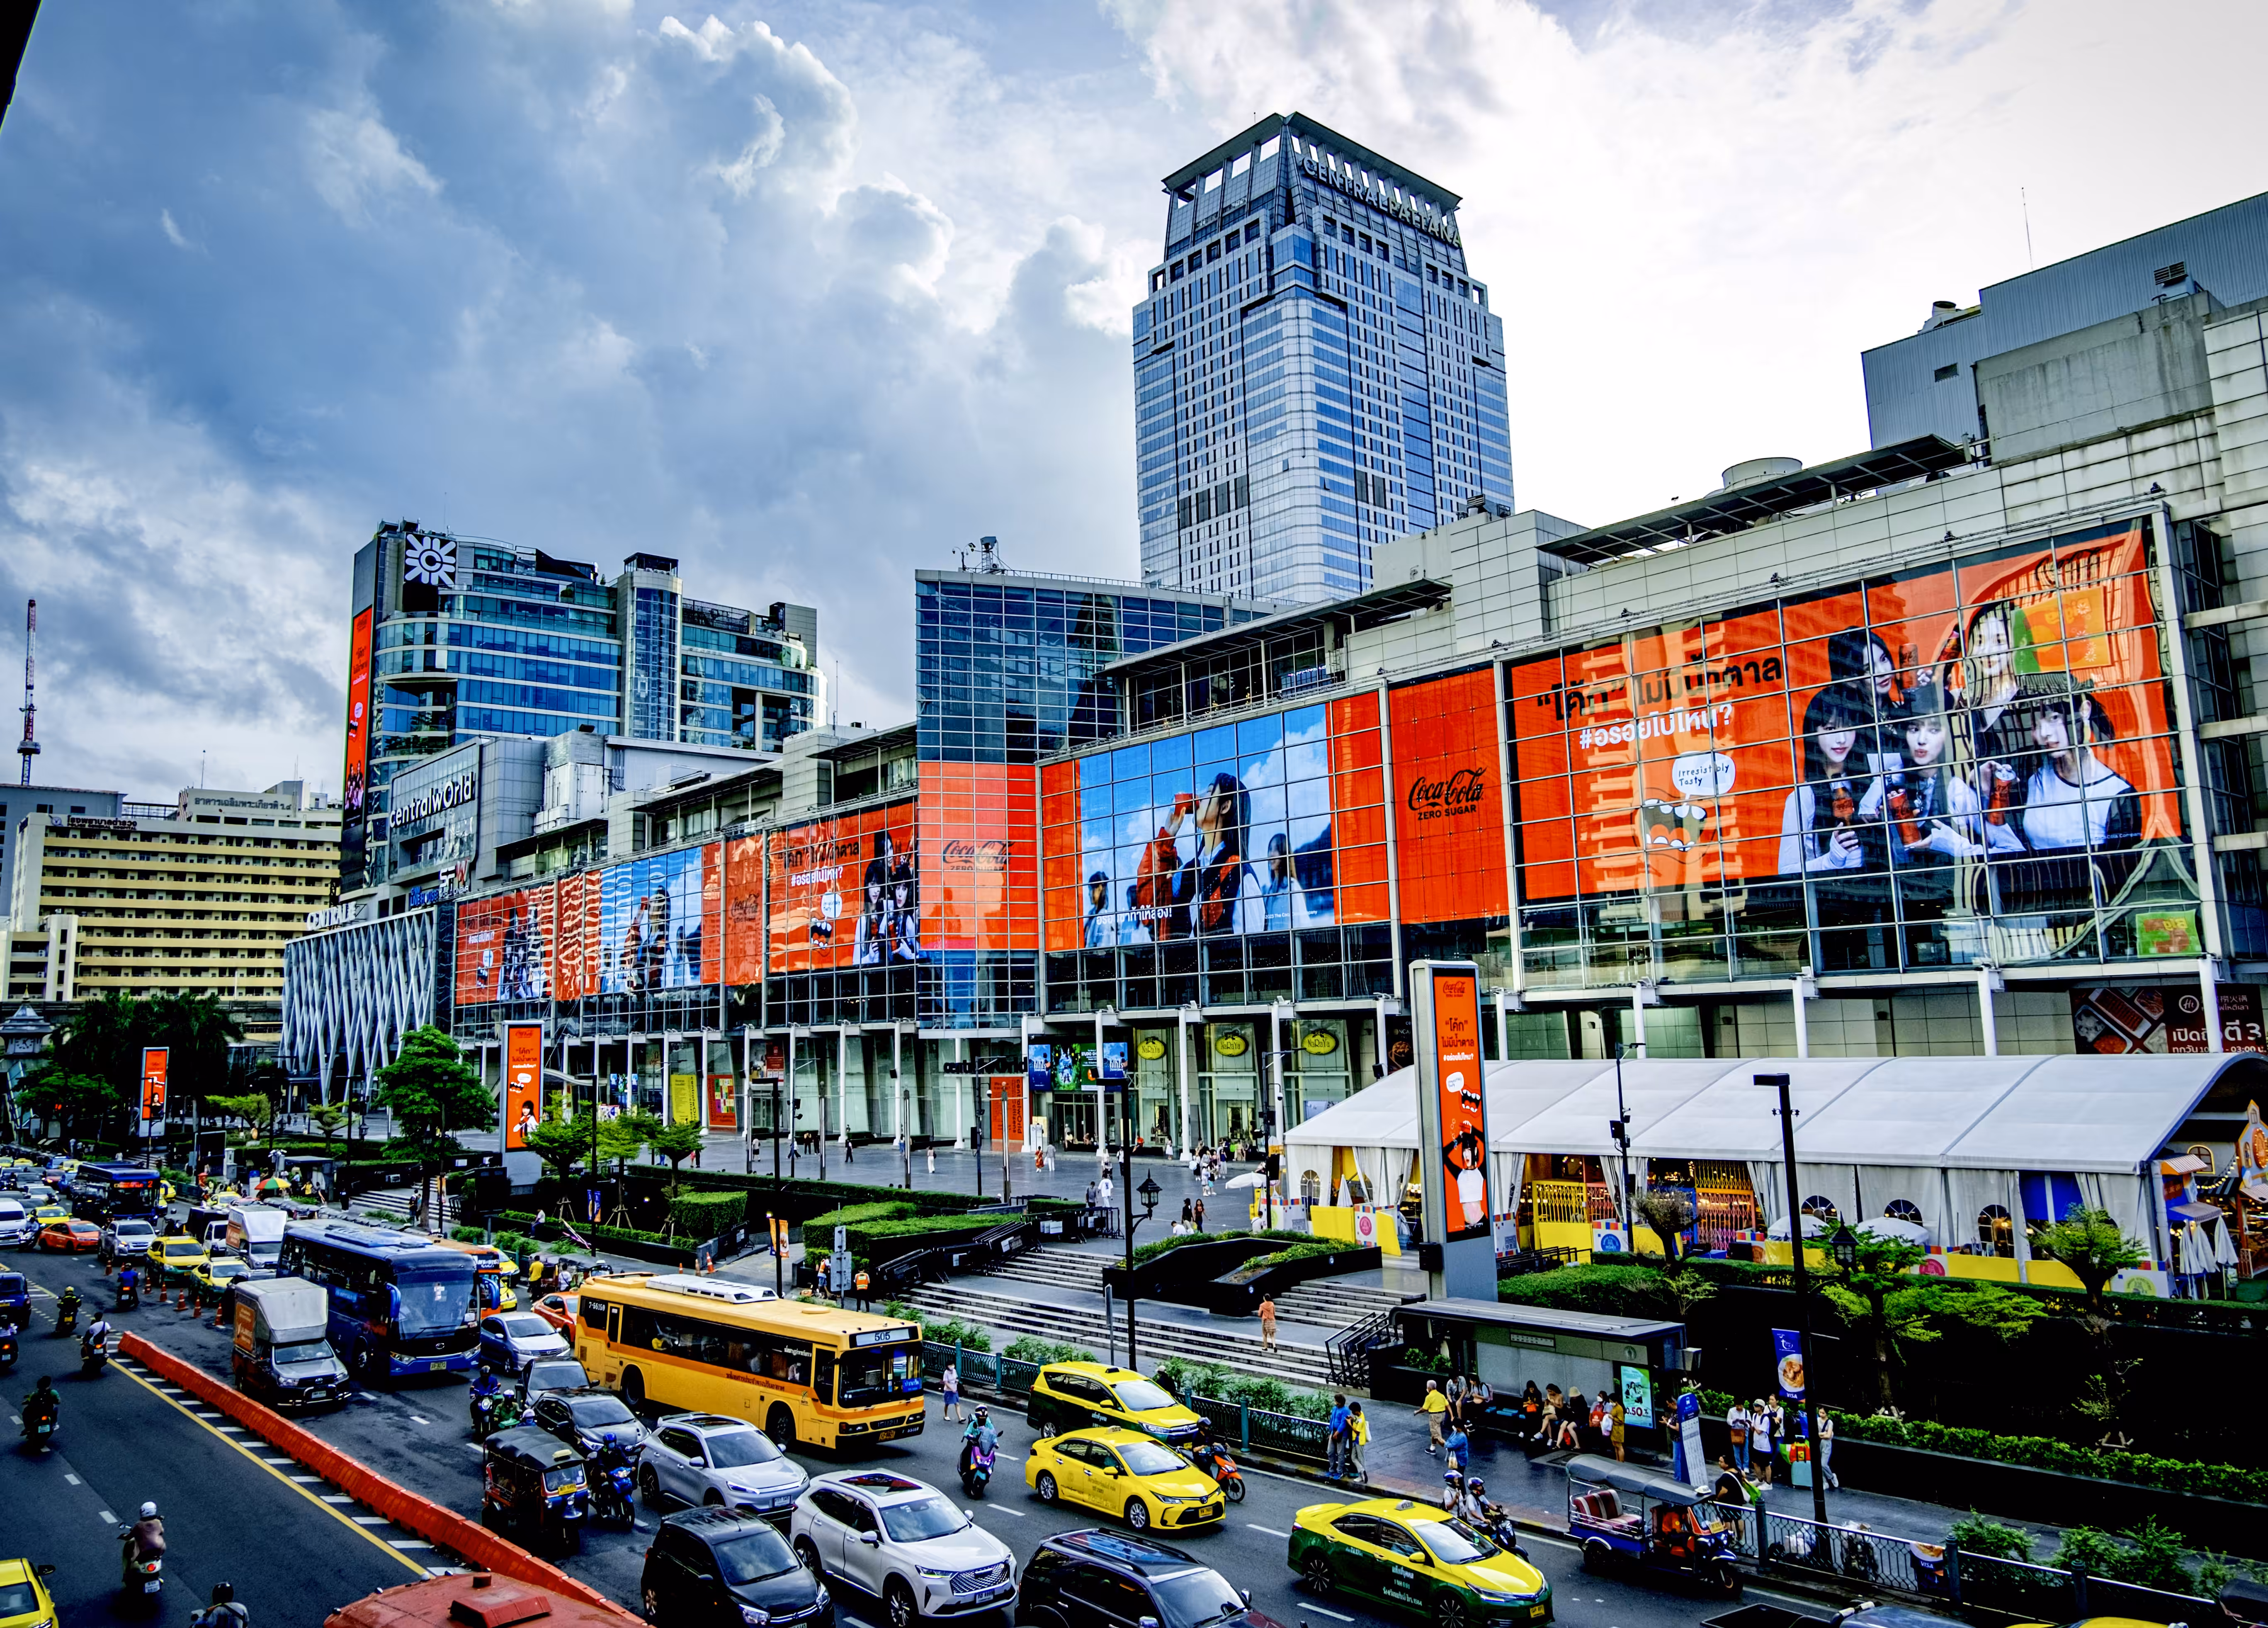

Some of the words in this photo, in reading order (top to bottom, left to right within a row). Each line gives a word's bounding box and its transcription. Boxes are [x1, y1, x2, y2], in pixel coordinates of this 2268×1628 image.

[1679, 763, 1729, 777] Irresistbly
[1679, 776, 1702, 786] Tasty
[1408, 767, 1488, 811] Coca-Cola
[1418, 810, 1442, 820] ZERO
[1445, 804, 1476, 816] SUGAR
[1443, 981, 1466, 994] Coca-Cola
[1445, 1017, 1468, 1032] “โค้ก”
[1221, 1041, 1241, 1050] NaRaYa
[1308, 1038, 1330, 1049] NaRaYa
[1441, 1033, 1475, 1047] ไม่มีน้ำตาล
[1142, 1045, 1160, 1053] NaRaYa
[589, 1302, 605, 1311] 7-55159
[874, 1332, 891, 1341] 505
[1920, 1560, 1934, 1569] VISA
